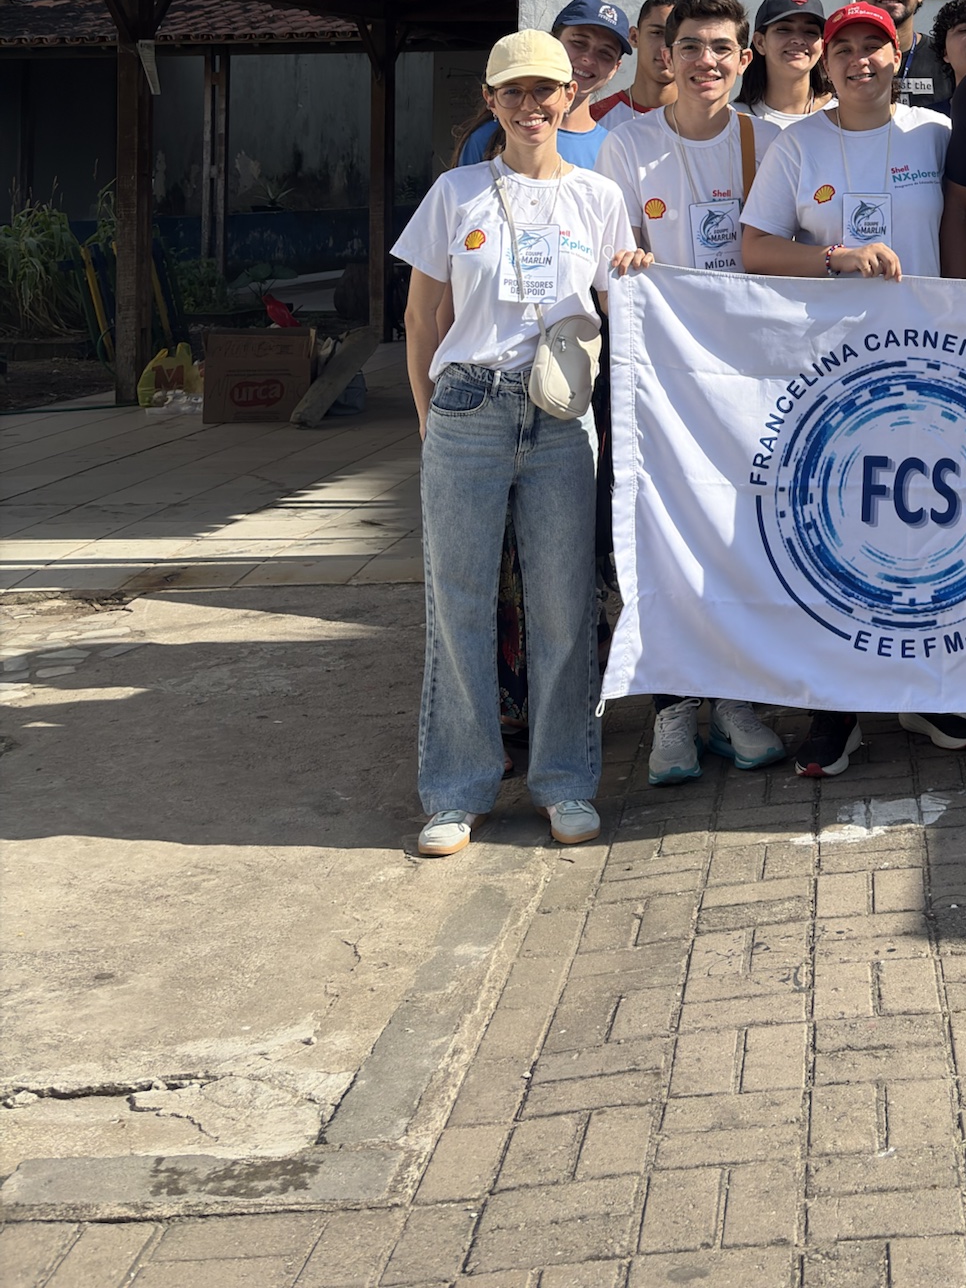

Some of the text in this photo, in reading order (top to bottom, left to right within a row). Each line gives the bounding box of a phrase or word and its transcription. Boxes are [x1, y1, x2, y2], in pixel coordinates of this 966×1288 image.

[915, 81, 932, 90] the
[891, 165, 910, 174] Shell
[712, 189, 732, 198] Shell
[860, 226, 887, 235] MARLIN
[710, 232, 737, 241] MARLIN
[520, 256, 553, 266] MARLIN
[705, 258, 737, 270] MÍDIA
[233, 382, 281, 402] urca
[749, 343, 858, 485] FRANCELINA
[861, 455, 961, 527] FCS
[853, 630, 965, 658] EEEFM
